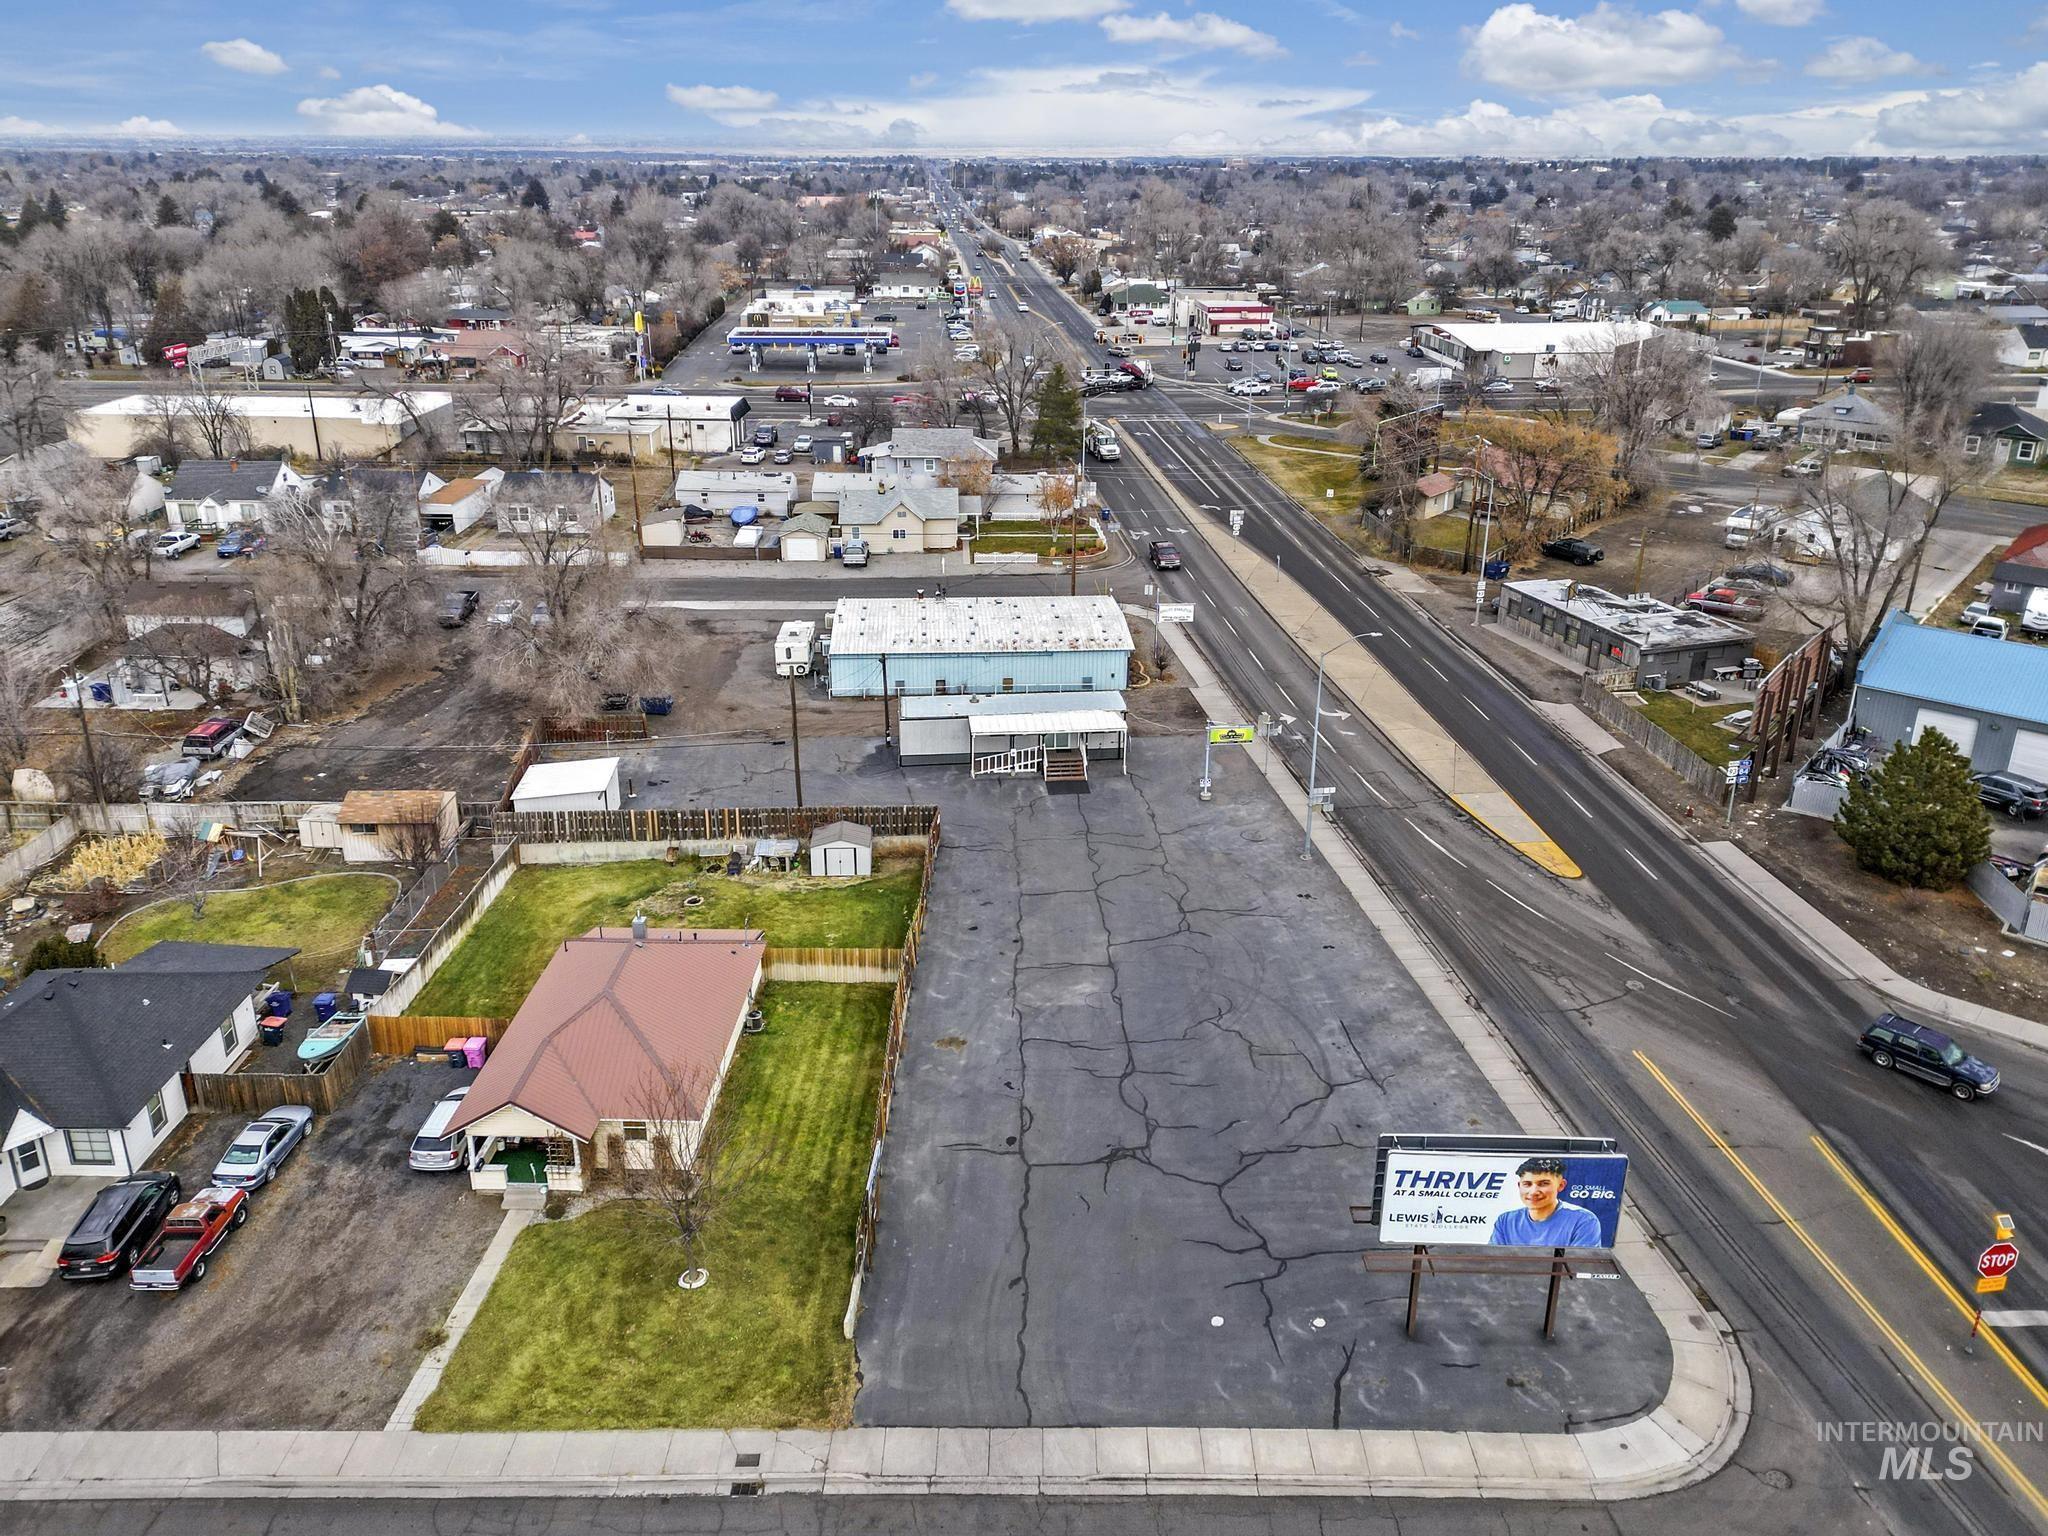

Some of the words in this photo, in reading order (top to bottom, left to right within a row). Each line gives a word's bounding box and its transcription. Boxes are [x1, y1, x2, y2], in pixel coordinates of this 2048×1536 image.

[1395, 1169, 1507, 1190] THRIVE
[1418, 1190, 1450, 1198] SMALL
[1453, 1191, 1499, 1199] COLLEGE
[1570, 1190, 1589, 1199] GO
[1591, 1190, 1616, 1199] BIG.
[1389, 1213, 1429, 1223] LEWIS
[1443, 1215, 1487, 1224] CLARK
[1981, 1253, 2016, 1268] STOP
